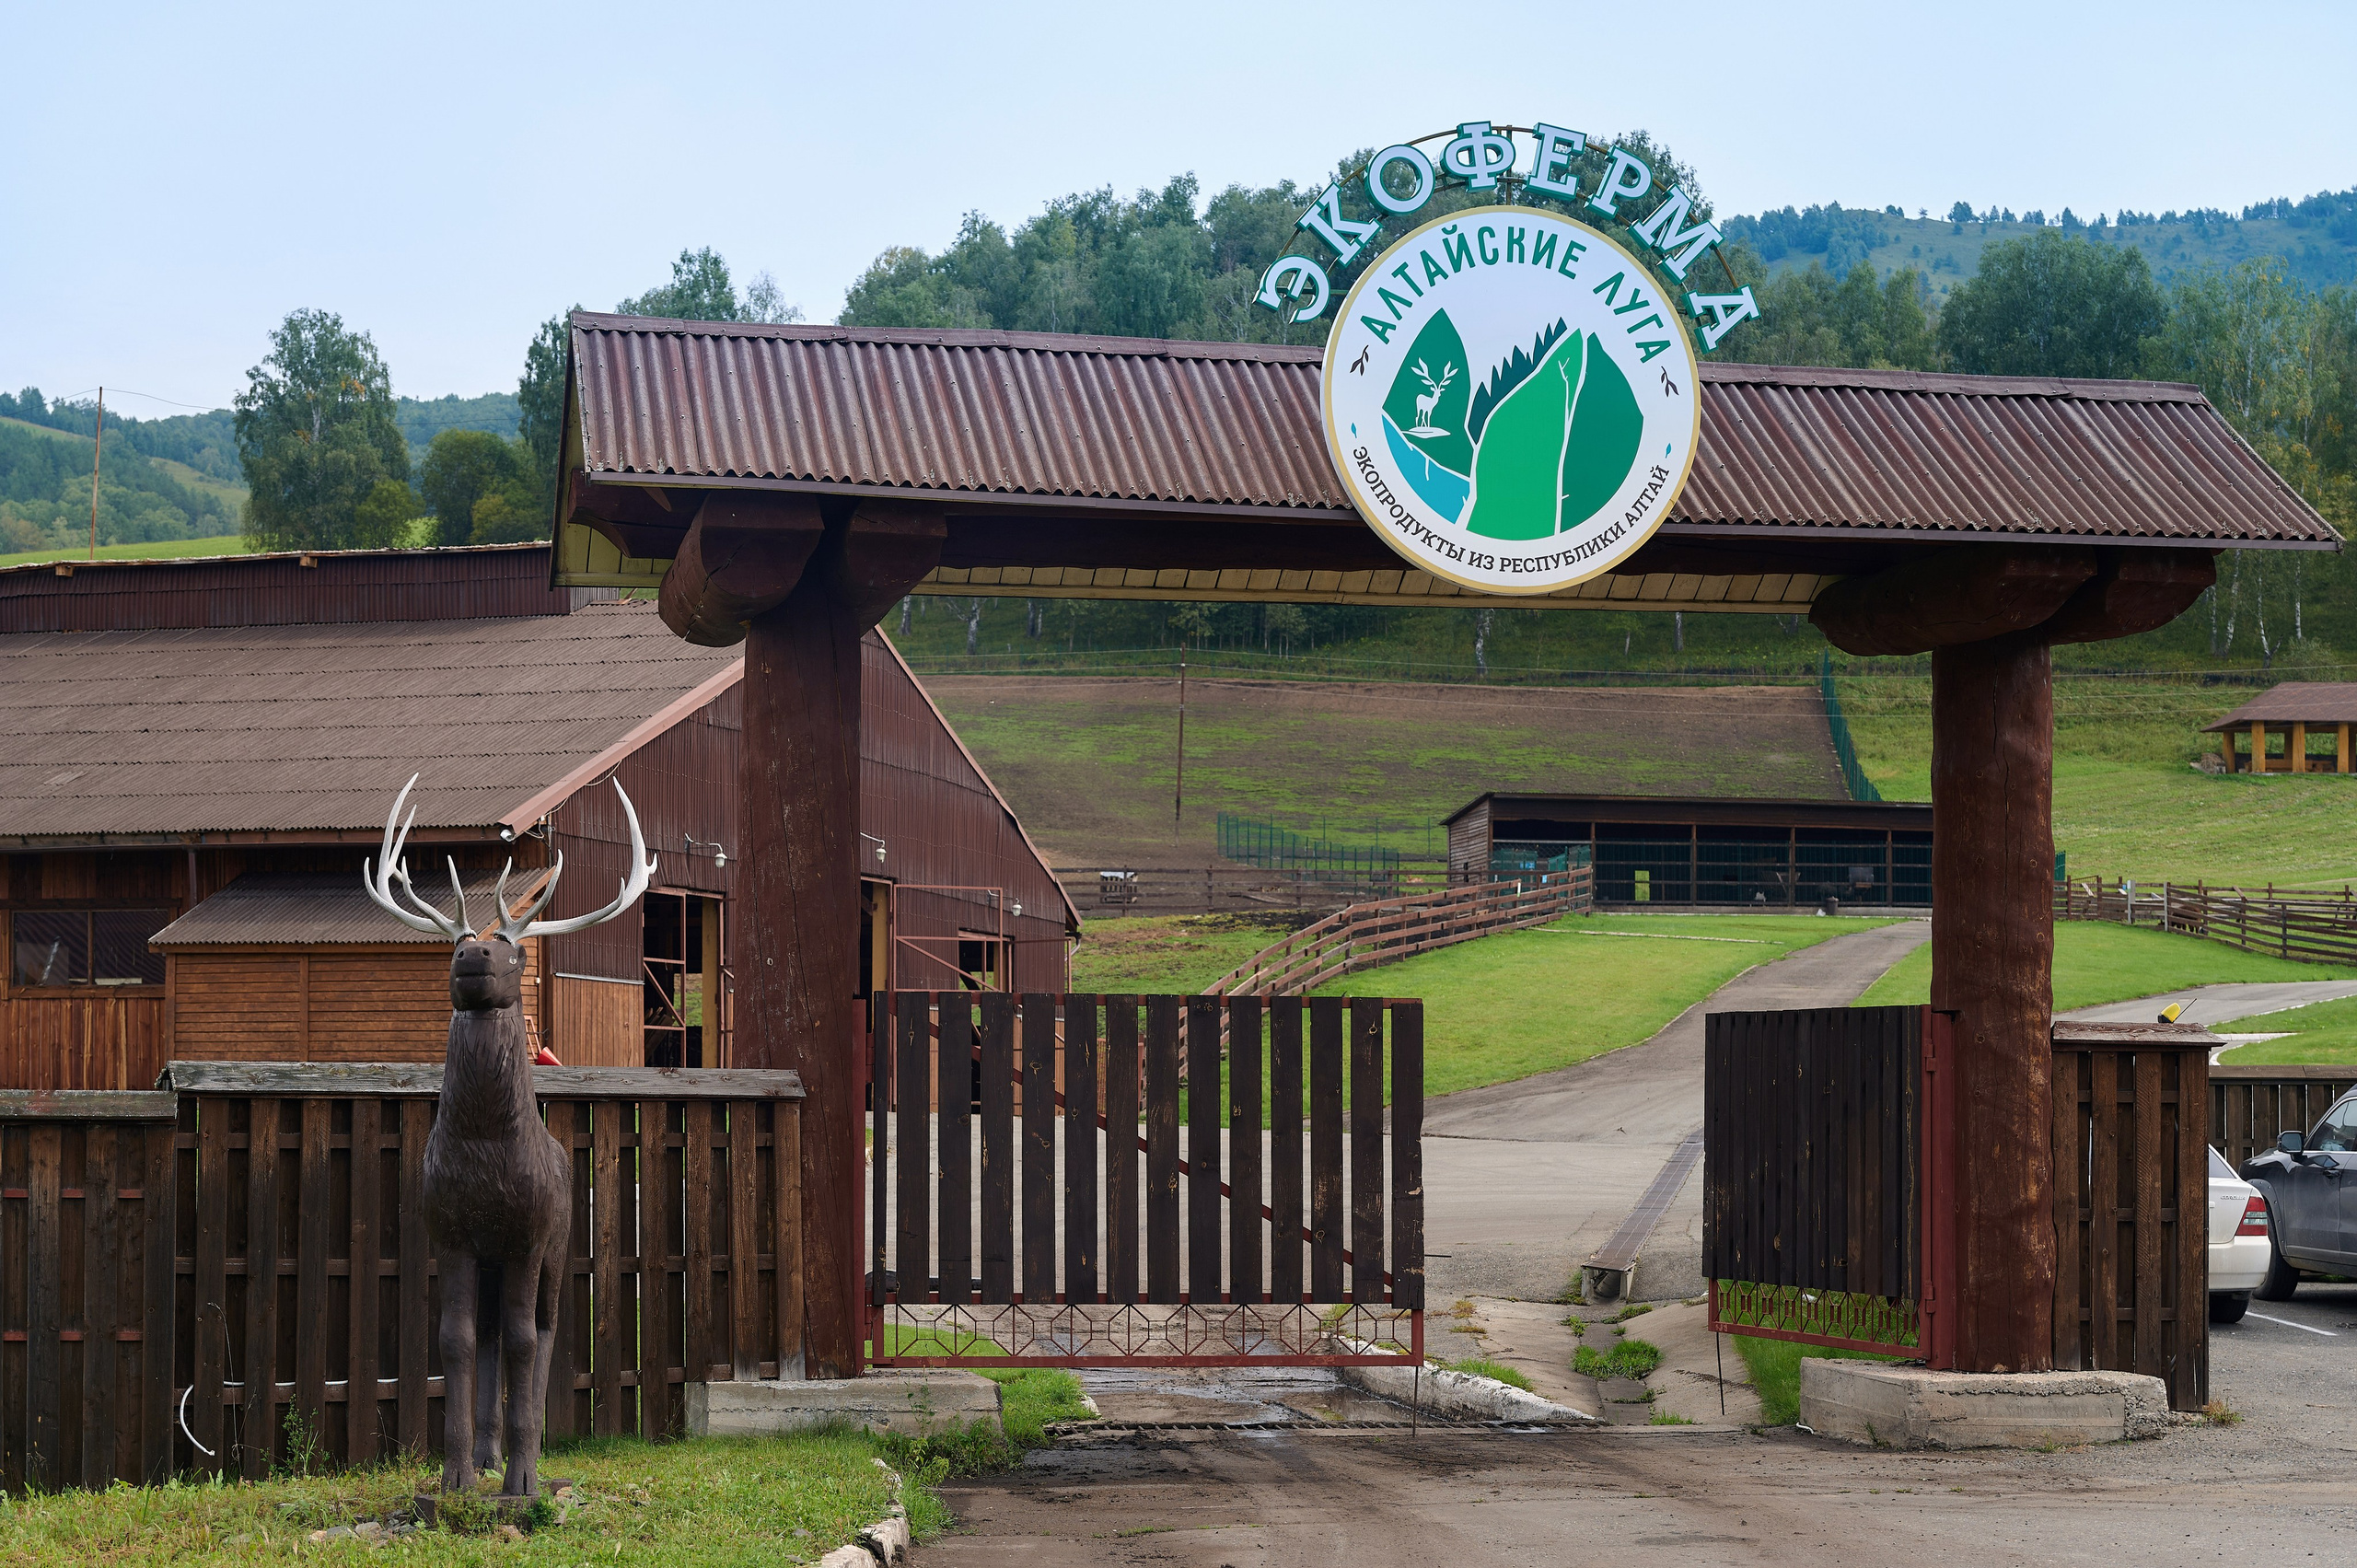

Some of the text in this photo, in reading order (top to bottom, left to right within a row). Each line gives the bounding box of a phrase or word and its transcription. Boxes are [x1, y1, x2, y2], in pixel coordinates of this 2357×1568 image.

[1253, 121, 1760, 354] ЭКОФЕРМА
[1361, 225, 1672, 365] АЛТАЙСКИЕ ЛУГА
[1353, 447, 1670, 574] ЭКОПРОДУКТЫ ИЗ РЕСПУБЛИКИ АЛТАЙ
